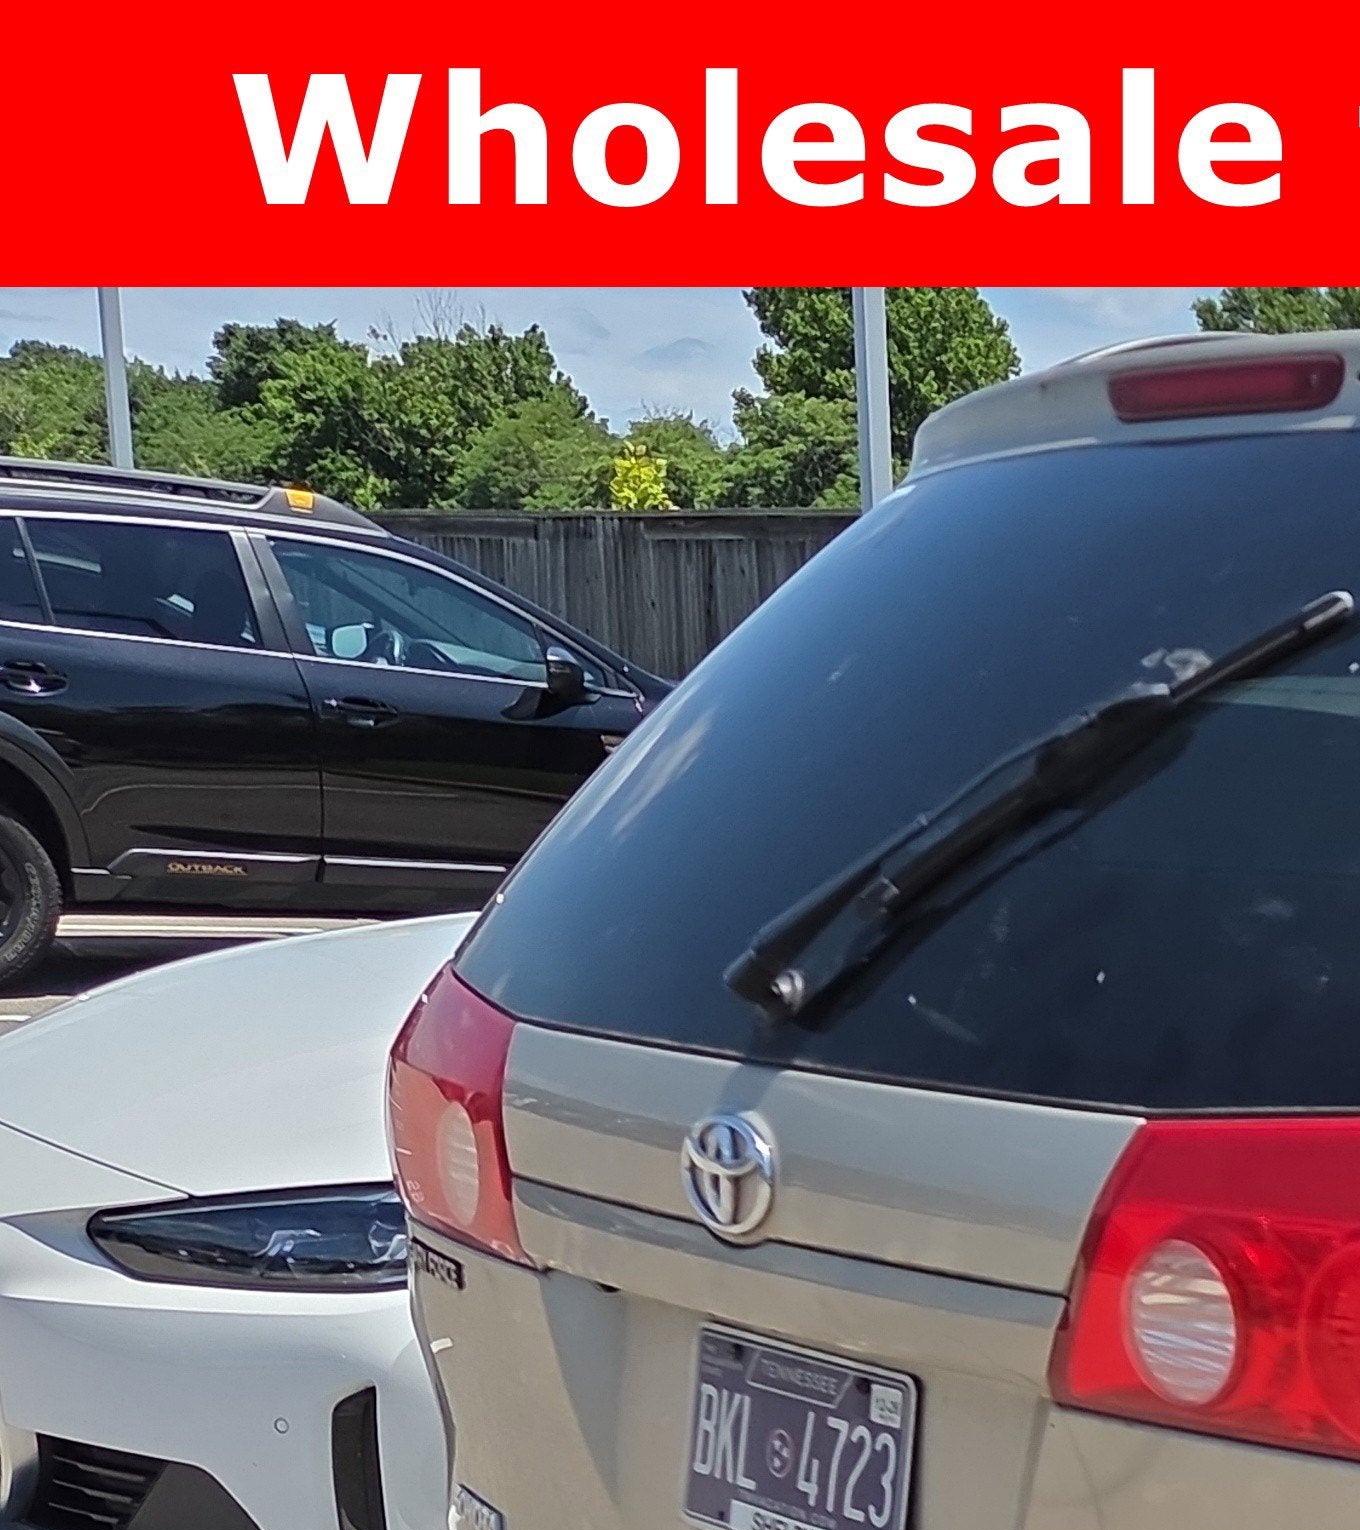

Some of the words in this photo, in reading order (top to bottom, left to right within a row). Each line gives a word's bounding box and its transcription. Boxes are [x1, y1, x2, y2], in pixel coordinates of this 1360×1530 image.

[167, 862, 248, 876] OUTBACK
[693, 1383, 757, 1491] BKL
[796, 1411, 898, 1530] 4723
